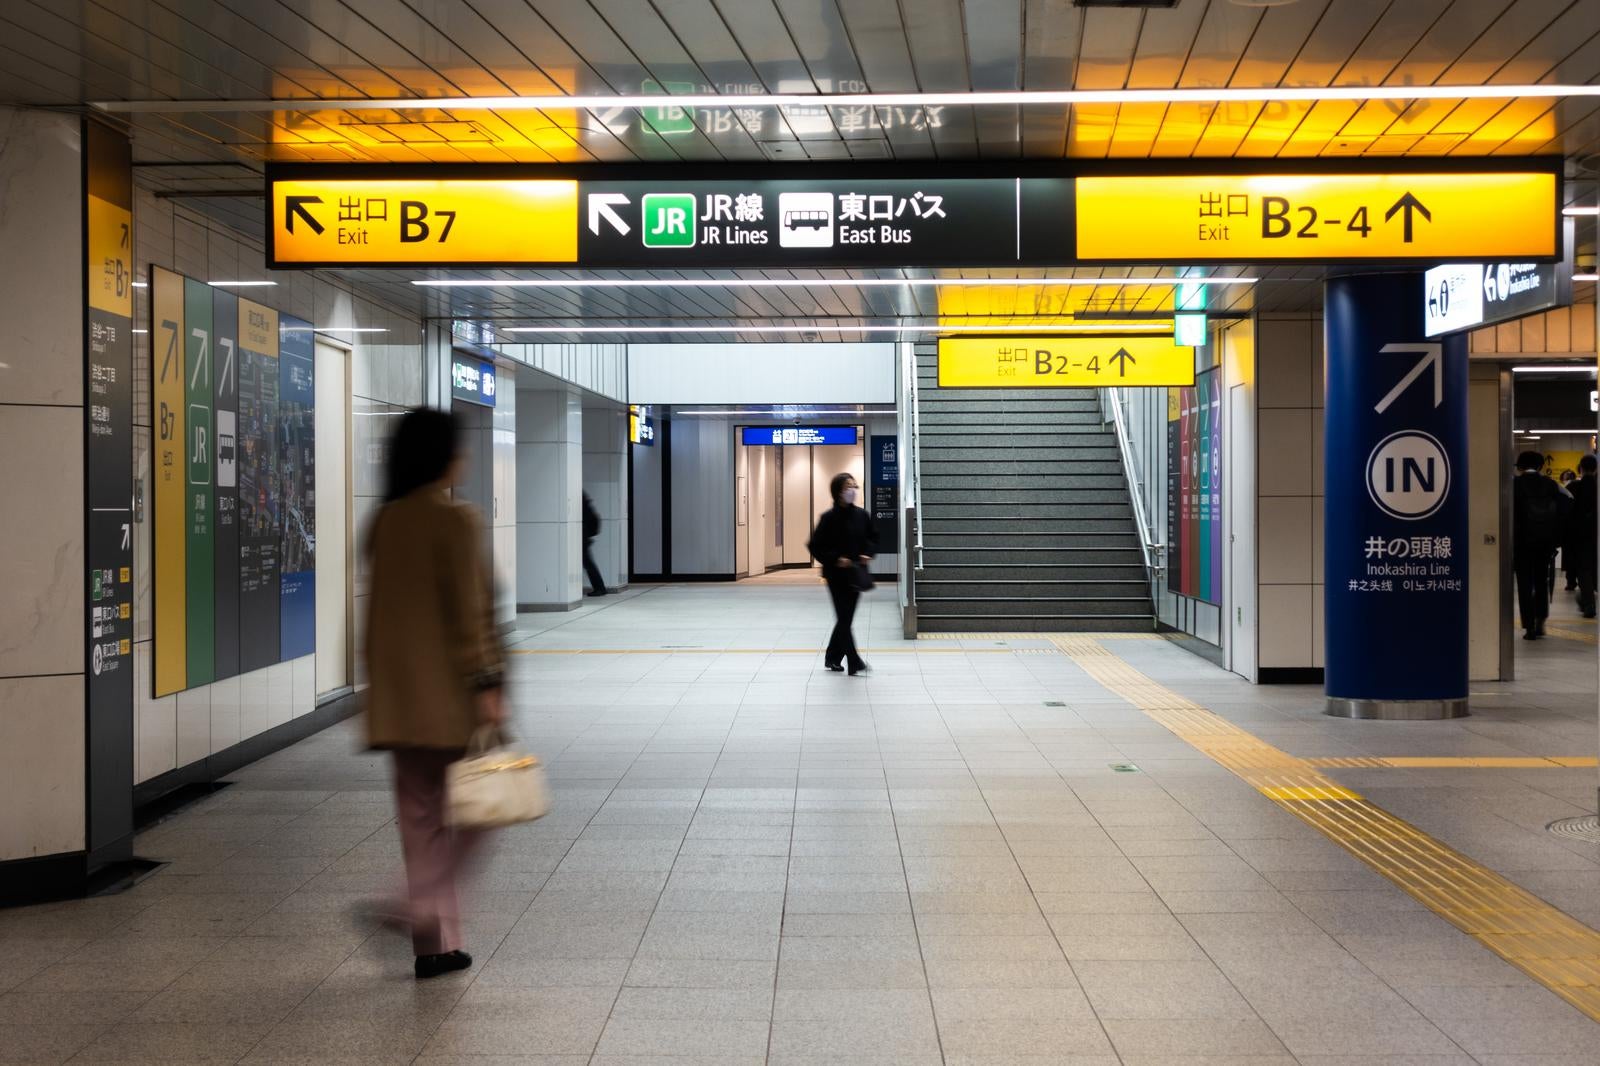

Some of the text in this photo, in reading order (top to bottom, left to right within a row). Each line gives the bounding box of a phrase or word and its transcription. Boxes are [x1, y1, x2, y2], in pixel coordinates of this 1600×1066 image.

[338, 195, 456, 243] 出口 B7
[701, 193, 764, 221] JR線
[838, 191, 947, 221] 東口バス
[1199, 191, 1372, 239] 出口 B2-4
[651, 207, 686, 235] JR
[701, 225, 768, 245] JR Lines
[840, 226, 912, 244] East Bus
[1199, 224, 1230, 241] Exit
[338, 228, 368, 245] Exit
[998, 347, 1101, 375] 出口 B2-4
[998, 366, 1016, 377] Exit
[160, 401, 175, 441] B7
[192, 426, 207, 464] JR
[1385, 457, 1435, 493] IN
[1364, 536, 1452, 559] 井の頭線
[1367, 562, 1450, 575] Inokashira Line
[1348, 579, 1393, 591] 井之头线
